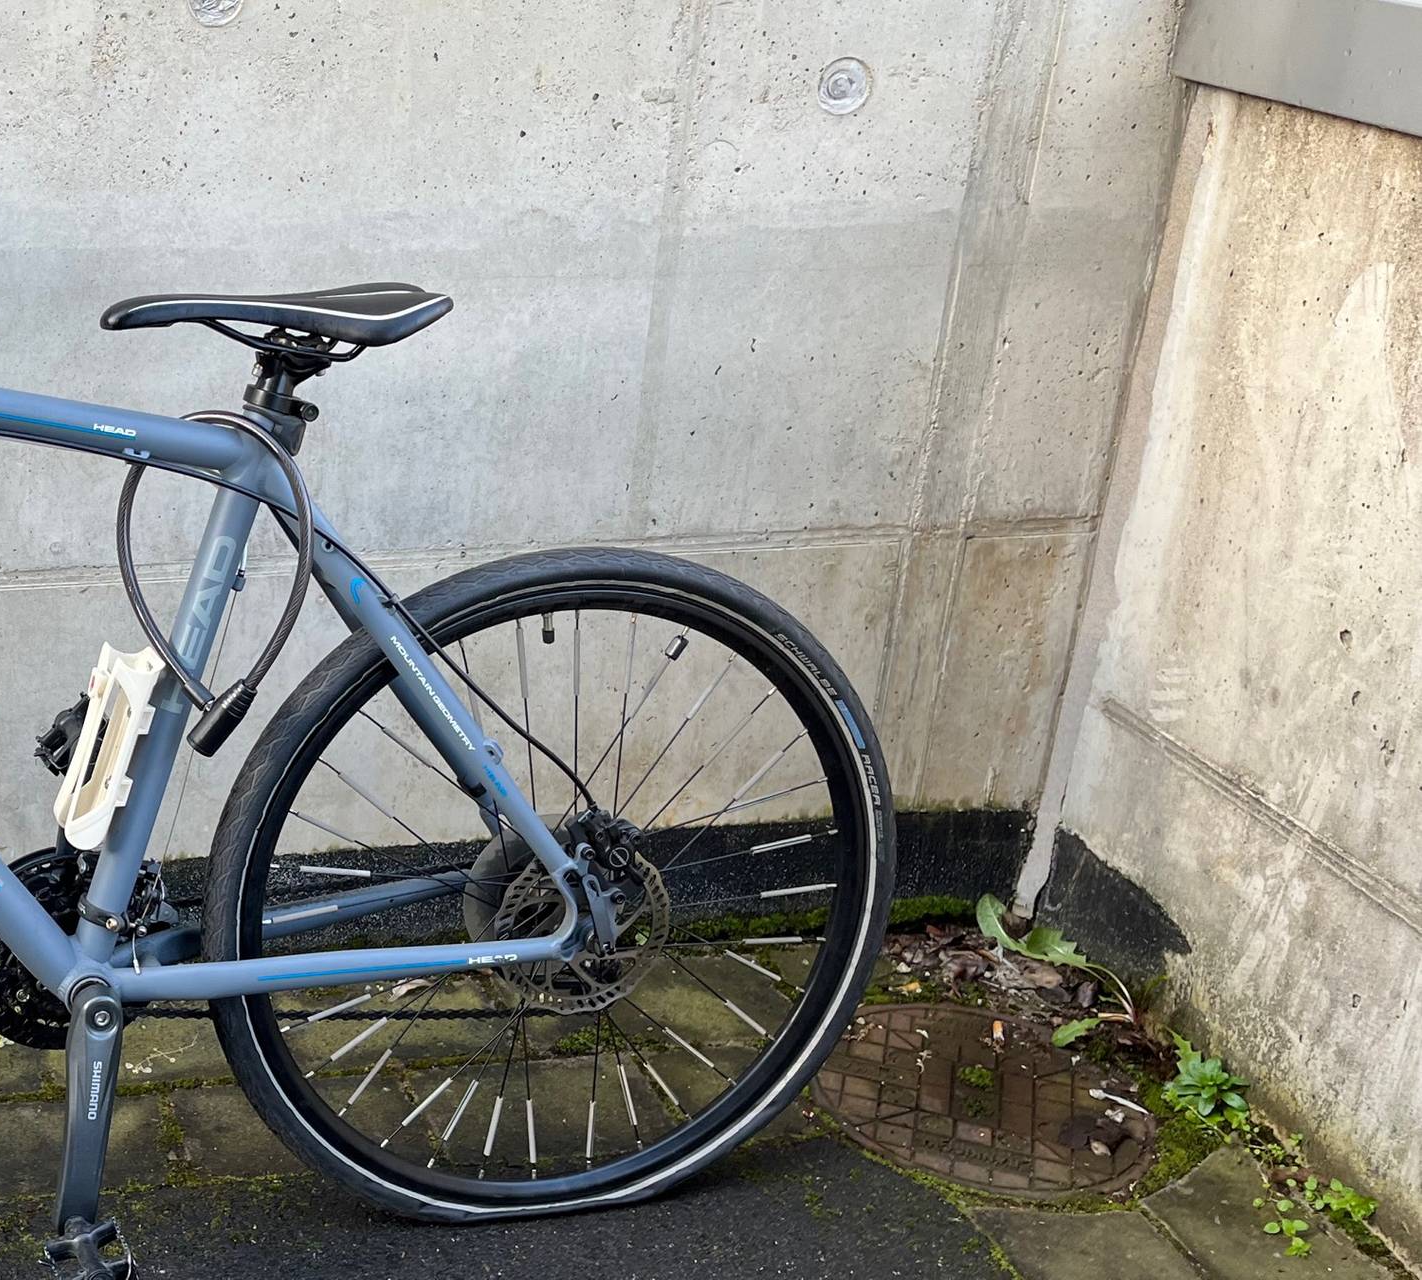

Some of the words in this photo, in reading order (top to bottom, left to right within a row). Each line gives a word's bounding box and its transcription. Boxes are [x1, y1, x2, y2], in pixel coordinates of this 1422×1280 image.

[93, 423, 137, 437] HEAD
[390, 635, 436, 697] MOUNTAIN
[432, 695, 476, 751] GEOMETRY
[774, 633, 838, 696] SCHWALBE
[87, 1061, 103, 1120] SHIMANO
